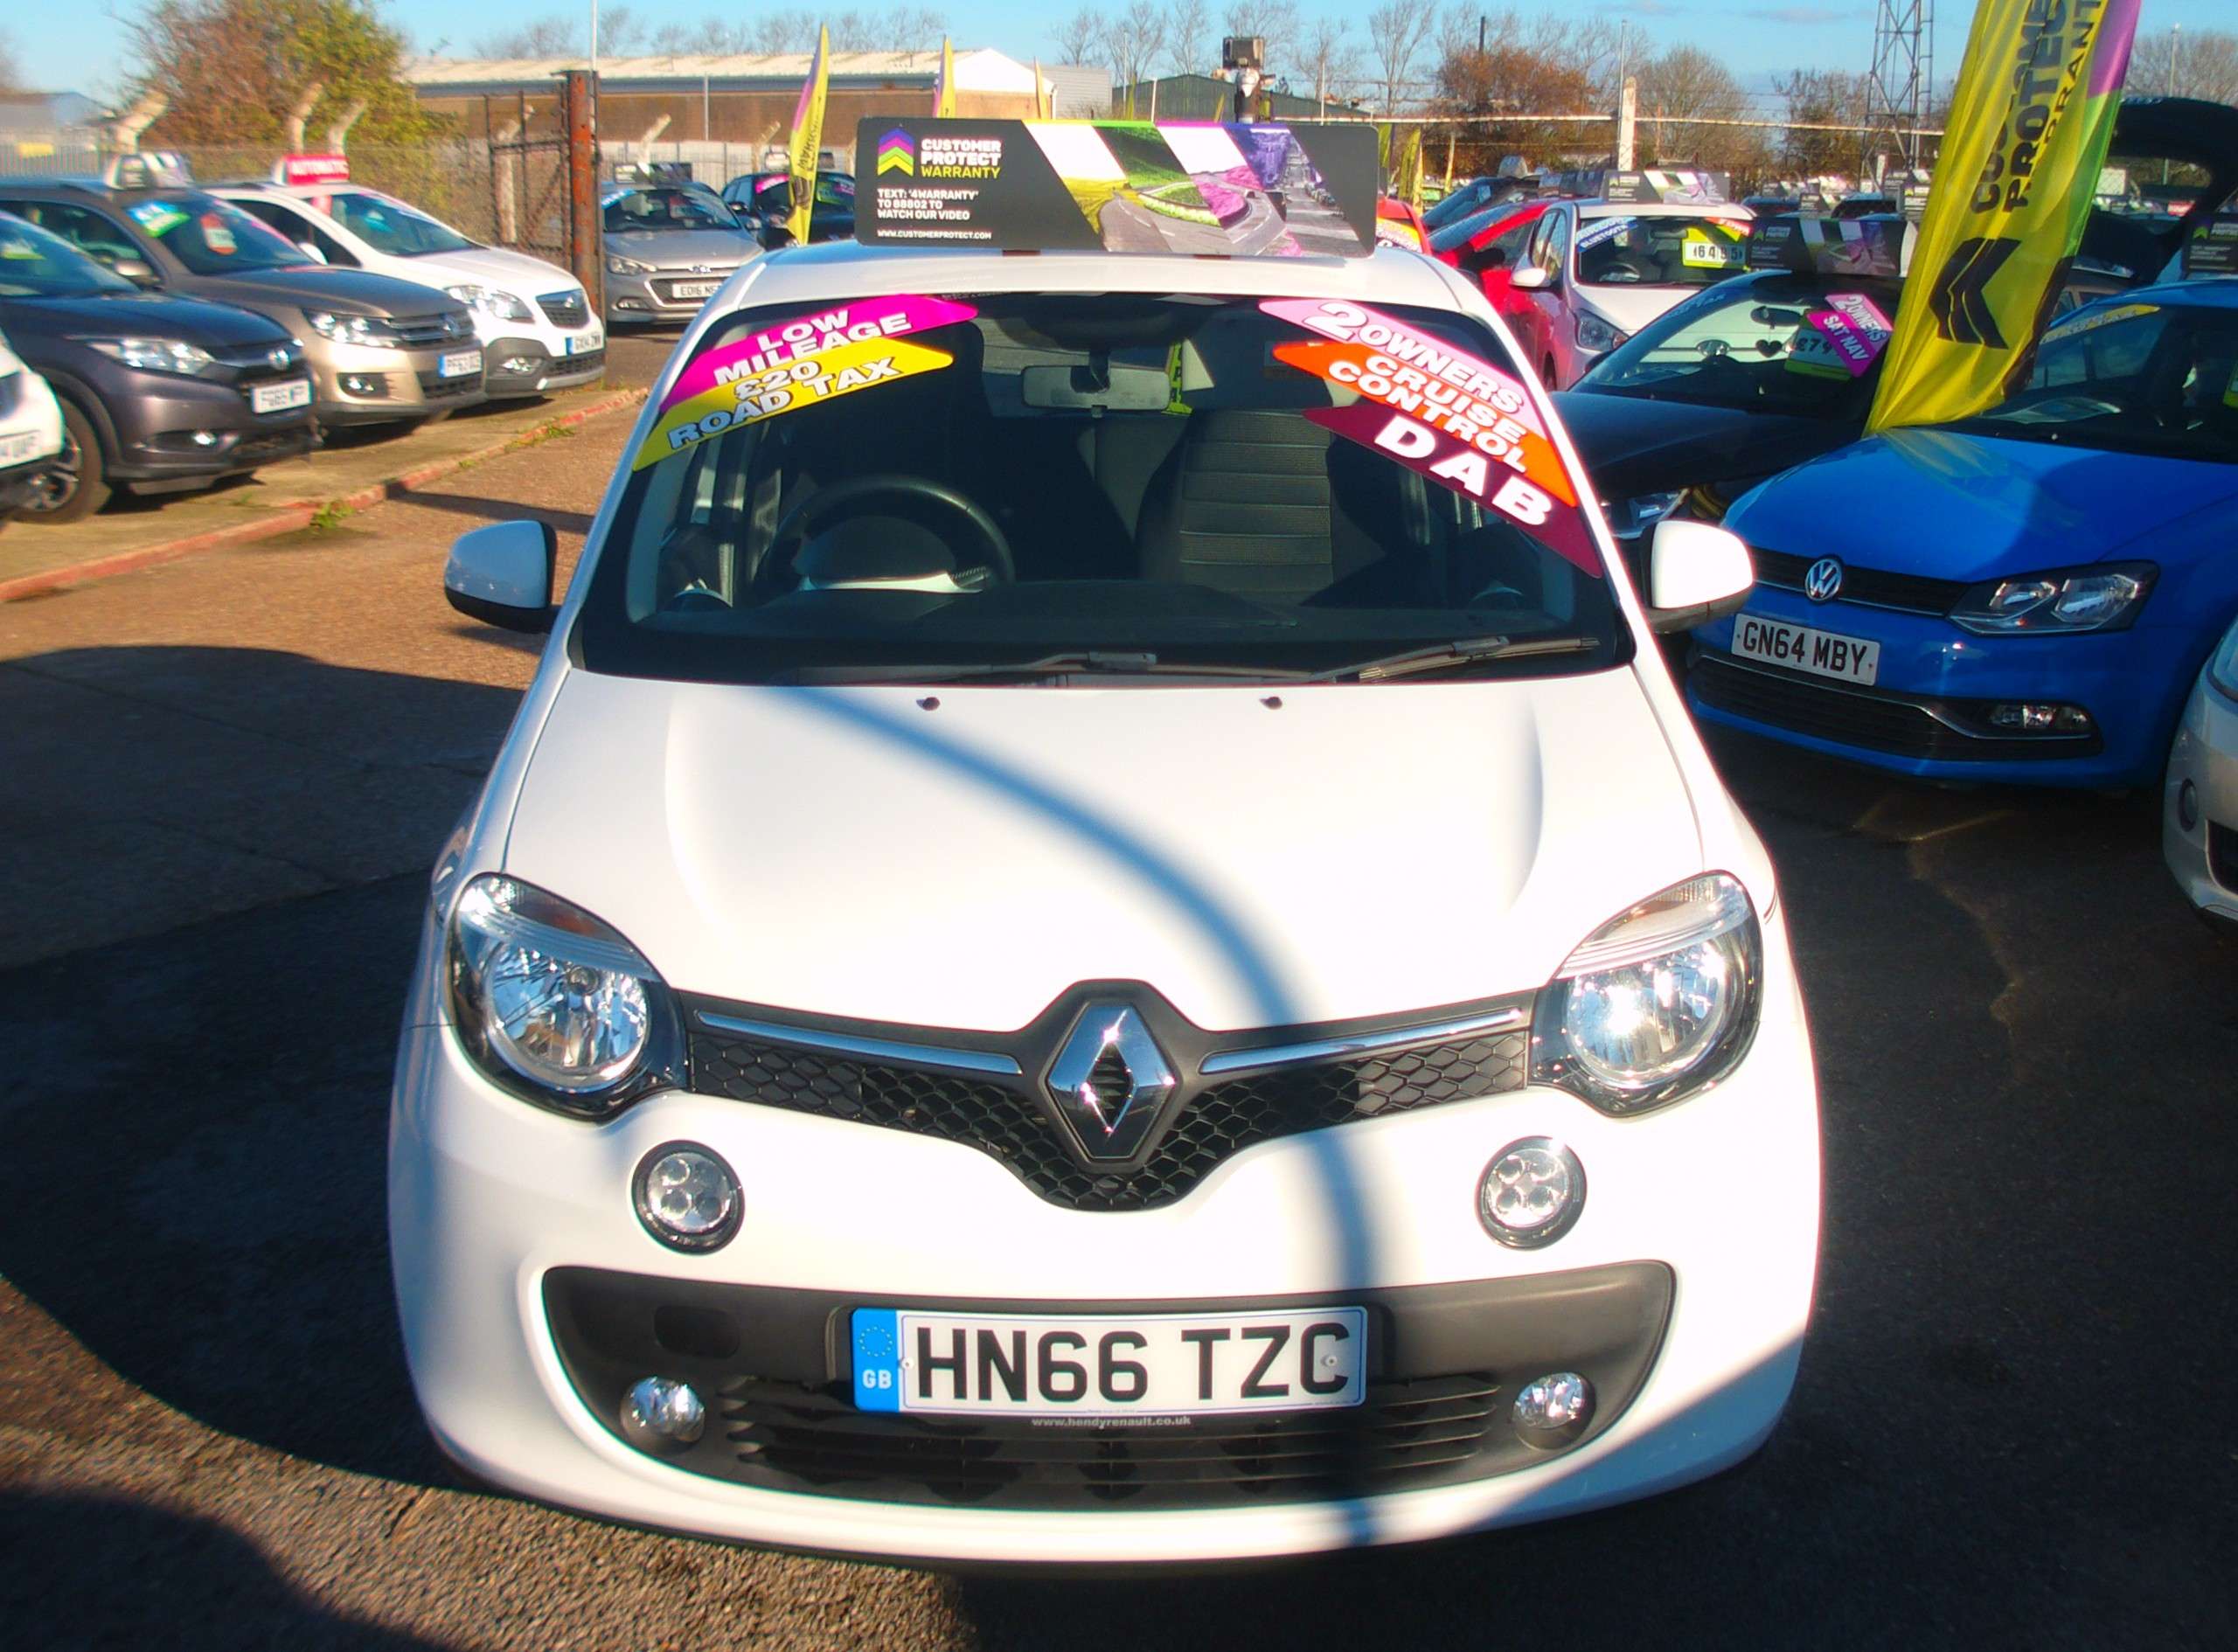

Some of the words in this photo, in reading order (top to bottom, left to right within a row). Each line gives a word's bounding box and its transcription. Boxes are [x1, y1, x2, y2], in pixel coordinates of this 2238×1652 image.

[921, 138, 1002, 153] CUSTOMER
[921, 151, 1002, 166] PROTECT
[921, 165, 1001, 179] WARRANTY
[877, 188, 907, 199] TEXT:
[877, 199, 892, 209] TO
[928, 200, 943, 210] TO
[877, 209, 914, 219] WATCH
[914, 210, 937, 219] OUR
[938, 210, 970, 220] VIDEO
[877, 229, 992, 239] WWW.CUSTOMERPROTECT.COM
[713, 312, 912, 385] MILEAGE
[757, 310, 850, 352] LOW
[1824, 315, 1850, 337] SAT
[1840, 336, 1869, 360] NAV
[733, 361, 823, 399] £20
[1357, 323, 1526, 415] OWNERS
[667, 390, 793, 449] ROAD
[803, 357, 903, 398] TAX
[1328, 360, 1527, 474] CONTROL
[1364, 355, 1526, 446] CRUISE
[1374, 416, 1553, 525] DAB
[1742, 621, 1805, 663] GN64
[1812, 635, 1867, 676] MBY
[862, 1369, 892, 1390] GB
[916, 1326, 1148, 1402] HN66
[1181, 1322, 1351, 1401] TZC
